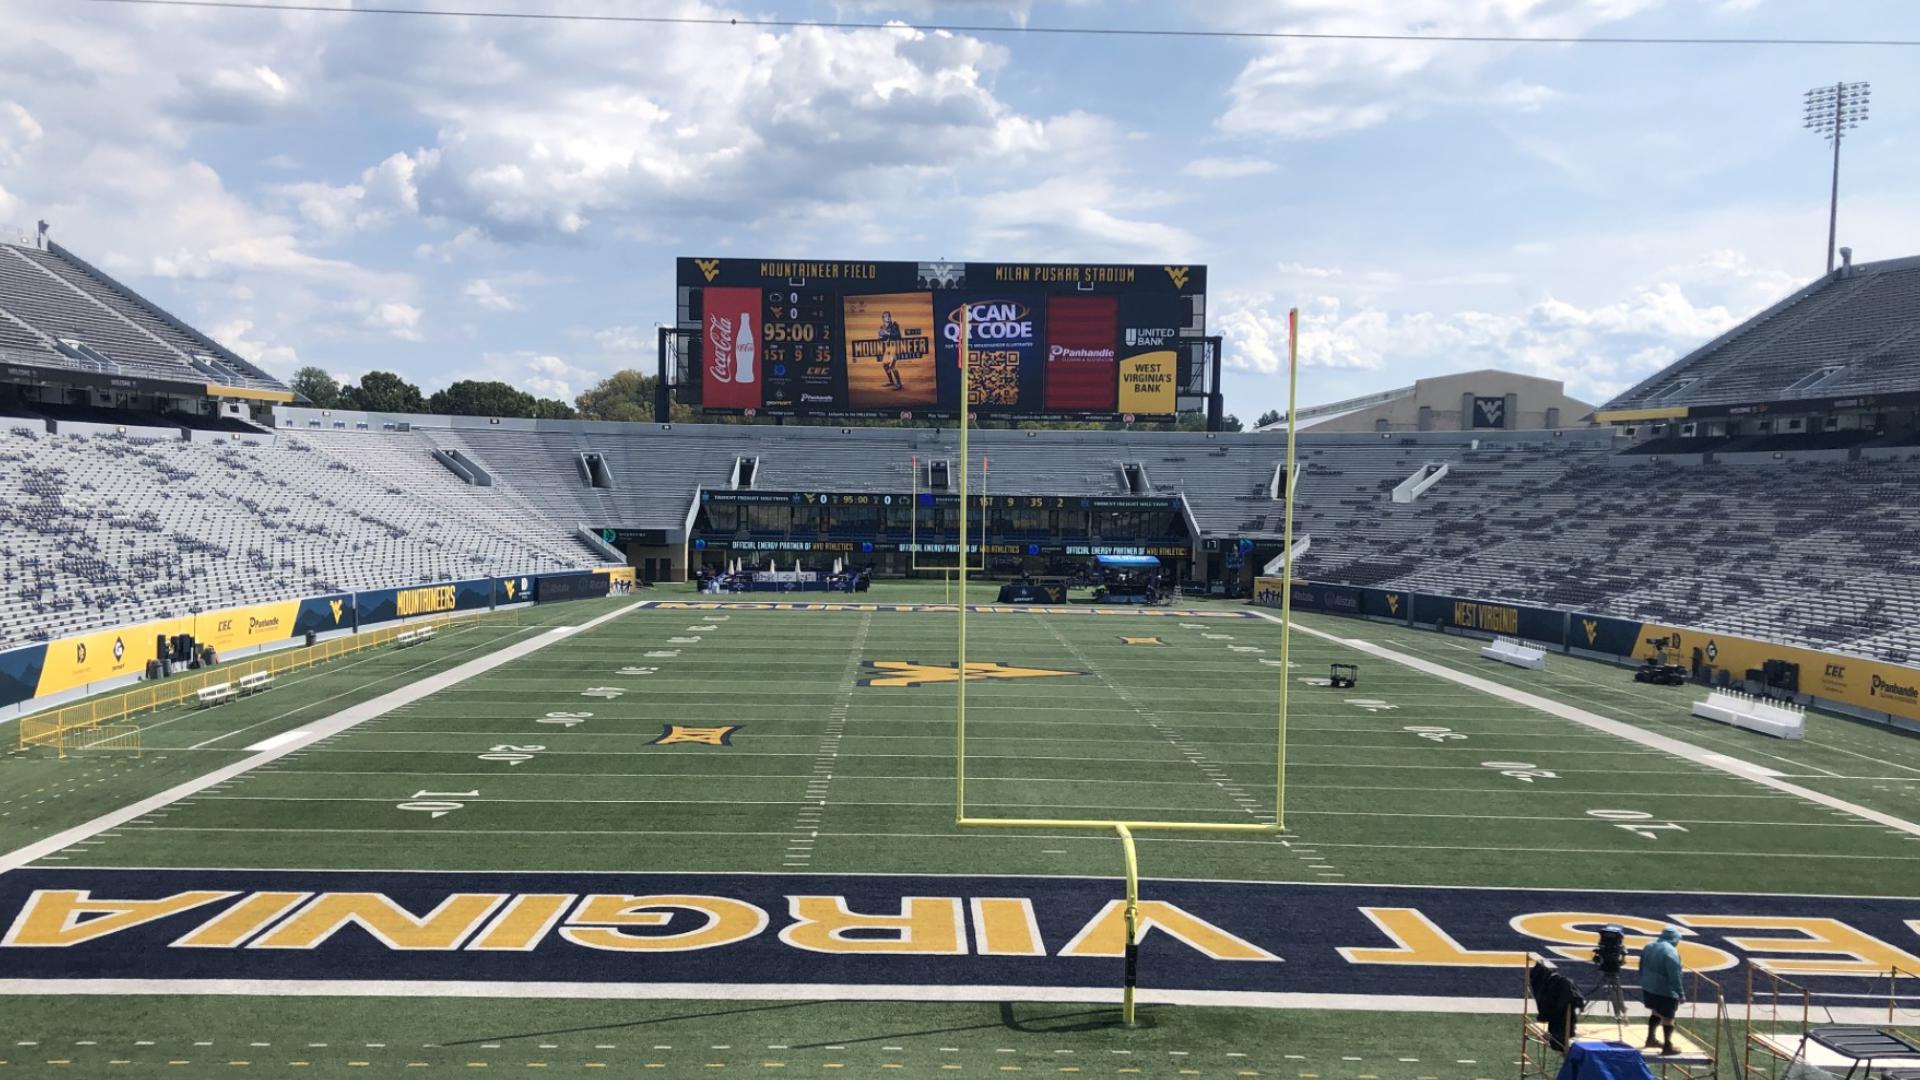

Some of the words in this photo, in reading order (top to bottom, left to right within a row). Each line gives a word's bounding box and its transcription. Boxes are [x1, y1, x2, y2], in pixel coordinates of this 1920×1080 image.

[761, 263, 839, 278] MOUNTAINEER
[844, 265, 876, 279] FIELD
[995, 267, 1030, 281] MILAN
[1034, 267, 1079, 281] PUSKAR
[1085, 268, 1135, 282] STADIUM
[790, 292, 798, 304] 0
[790, 308, 798, 319] 0
[764, 323, 814, 342] 95:00
[977, 322, 1032, 339] CODE
[1137, 329, 1175, 338] UNITED
[853, 338, 927, 357] MOUNINEER
[1137, 338, 1165, 346] BANK
[764, 350, 785, 361] 1ST
[795, 350, 803, 361] 9
[816, 350, 831, 362] 35
[1062, 347, 1114, 357] Panhandle
[1135, 364, 1161, 373] WEST
[1123, 374, 1172, 383] VIRGINIA'S
[1134, 384, 1161, 393] BANK
[820, 495, 828, 504] 0
[884, 495, 892, 505] 0
[1007, 498, 1014, 507] 9
[1030, 498, 1043, 507] 35
[1057, 499, 1064, 508] 2
[732, 541, 756, 550] OFFICIAL
[757, 542, 778, 550] ENERGY
[779, 542, 803, 551] PARTNER
[804, 542, 812, 551] OF
[924, 544, 945, 552] ENERGY
[946, 544, 969, 552] PARTR
[1066, 546, 1089, 555] OFFICIAL
[1090, 546, 1112, 555] ENERGY
[1113, 546, 1137, 555] PARTNER
[1138, 547, 1146, 555] OF
[396, 585, 456, 616] MOUNTAINEERS
[1455, 601, 1477, 628] WEST
[1478, 604, 1518, 634] VIRGINIA
[477, 745, 546, 761] 20
[1480, 761, 1563, 779] 20
[396, 789, 480, 811] 10
[1586, 809, 1690, 833] 10
[0, 888, 1286, 962] VIRGINIA
[1334, 905, 1920, 979] EST
